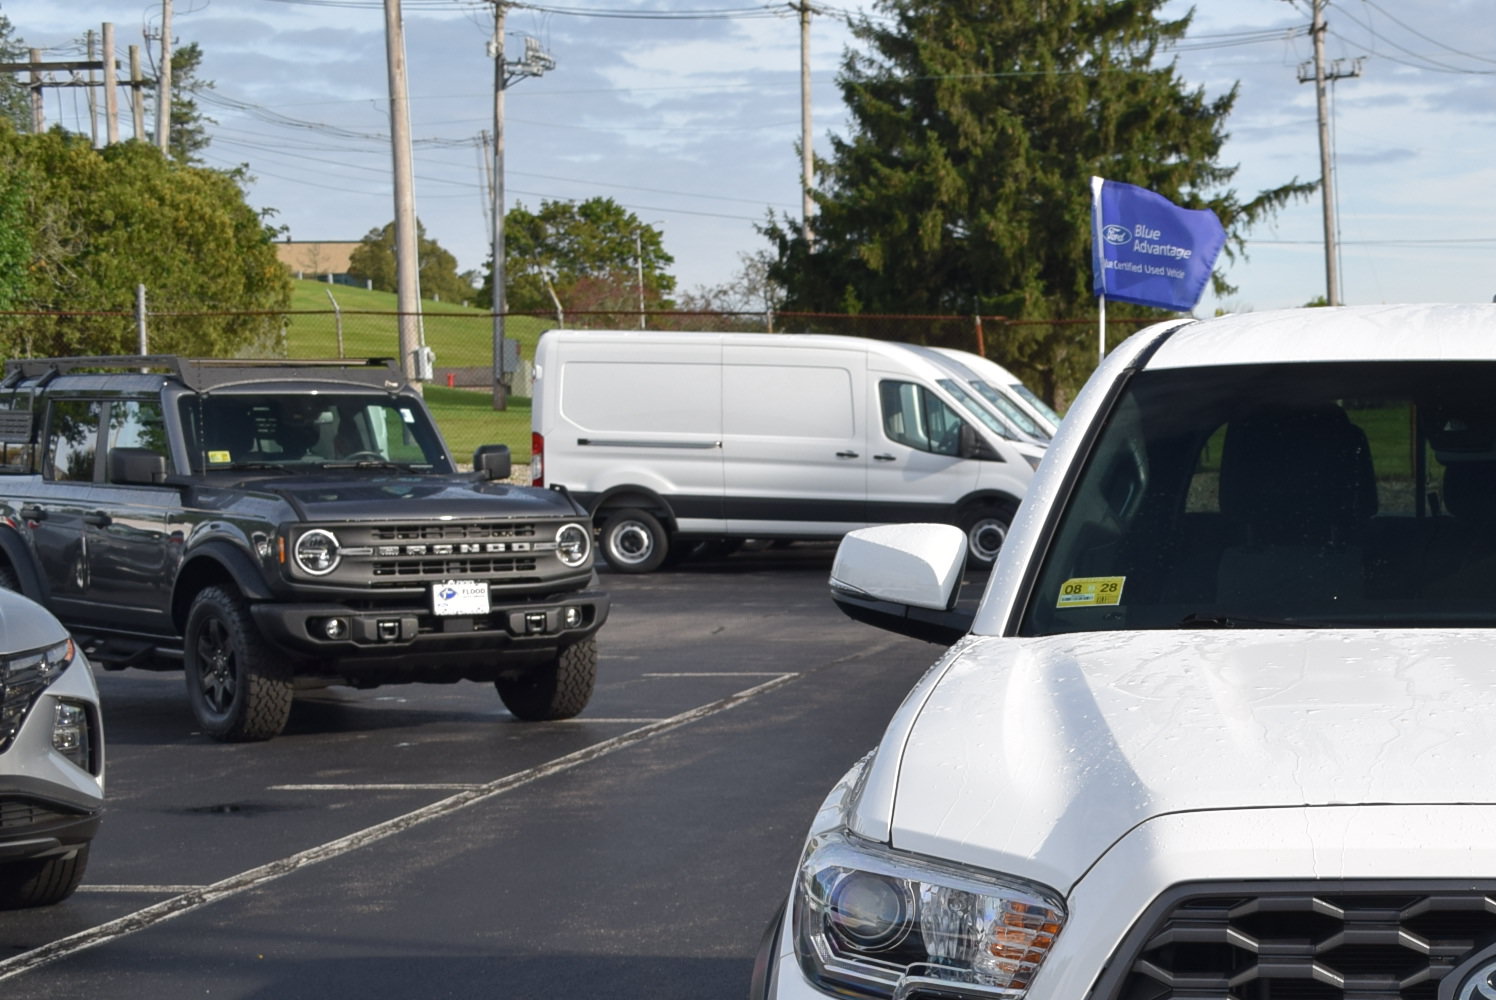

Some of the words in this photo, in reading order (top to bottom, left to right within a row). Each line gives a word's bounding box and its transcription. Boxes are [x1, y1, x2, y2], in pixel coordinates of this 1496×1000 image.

[1106, 226, 1126, 242] Ford
[1135, 224, 1161, 240] Blue
[1133, 240, 1192, 260] Advantage
[1114, 260, 1142, 273] Certified
[1144, 264, 1165, 276] Used
[379, 542, 530, 556] BRONCO
[1064, 584, 1082, 594] 08
[1100, 583, 1118, 593] 28
